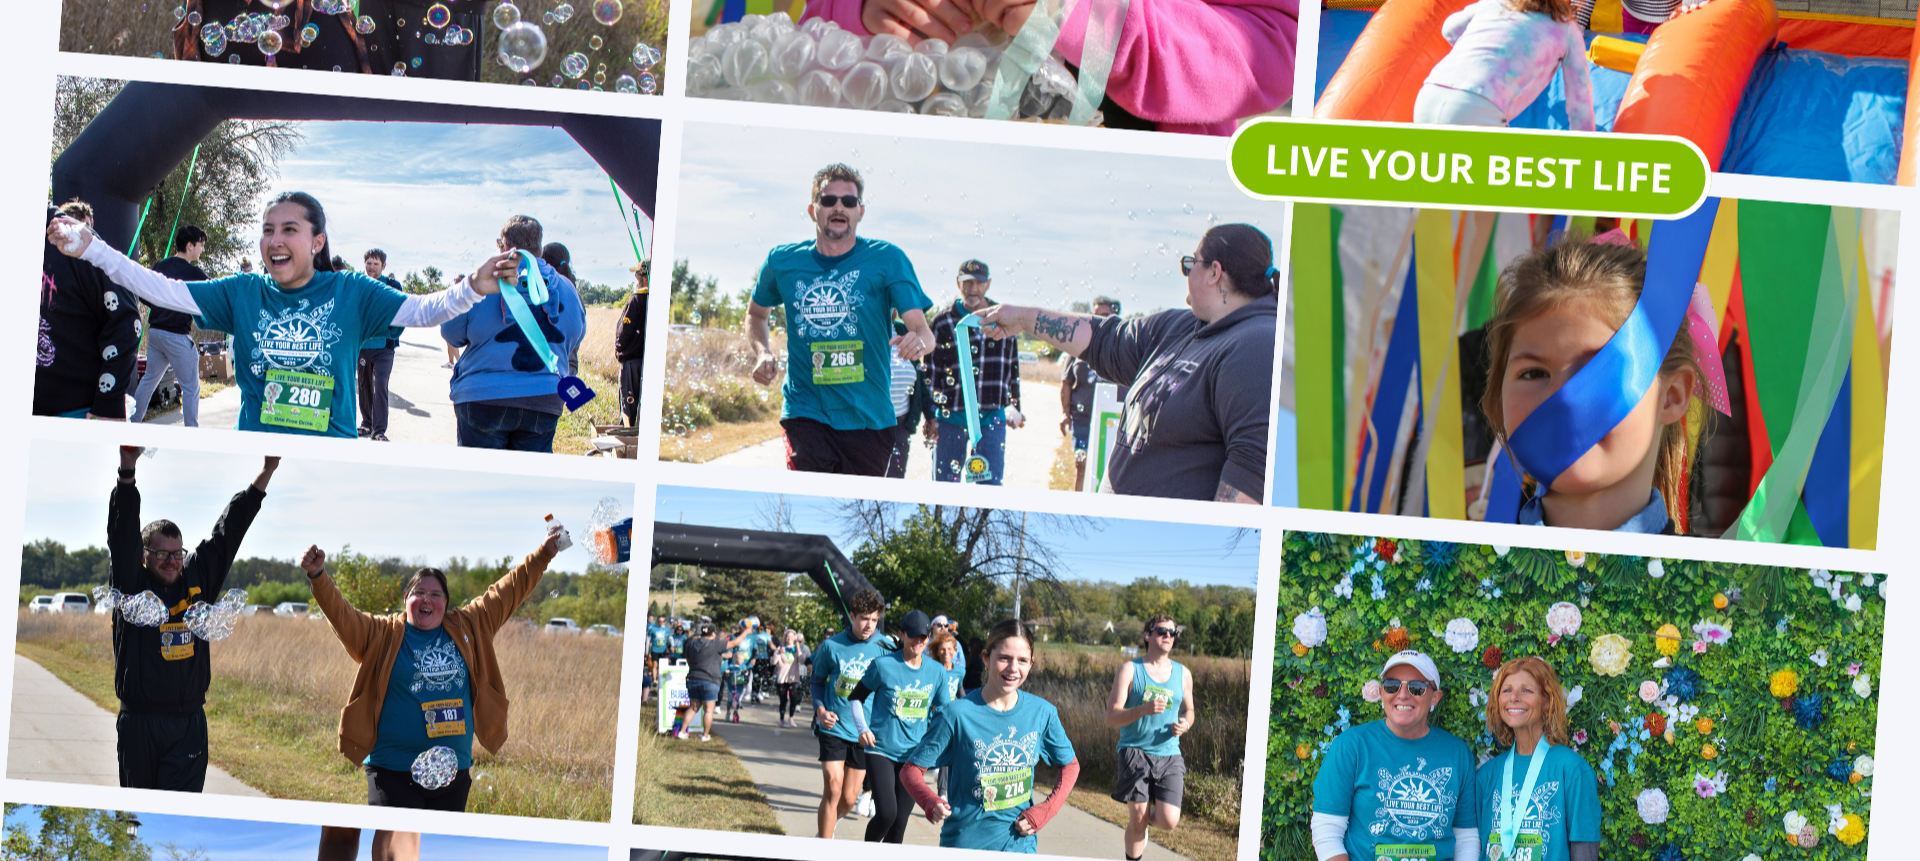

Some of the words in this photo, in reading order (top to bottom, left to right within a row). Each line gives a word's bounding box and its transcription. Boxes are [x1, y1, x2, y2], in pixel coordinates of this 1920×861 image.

[261, 340, 274, 348] LIVE
[275, 340, 291, 349] YOUR
[292, 341, 307, 350] BEST
[309, 341, 323, 351] LIFE
[830, 351, 855, 366] 266
[287, 375, 300, 383] YOUR
[301, 377, 314, 385] BEST
[315, 379, 326, 387] LIFE
[288, 386, 321, 407] 280
[670, 689, 689, 699] BUBB
[910, 699, 922, 708] 277
[442, 709, 457, 721] 187
[1004, 781, 1024, 799] 274
[1386, 800, 1399, 808] LIVE
[1400, 801, 1415, 809] YOUR
[1416, 803, 1430, 811] BEST
[1431, 804, 1443, 812] LIFE
[1533, 820, 1542, 828] LIFE
[1508, 847, 1533, 861] 283
